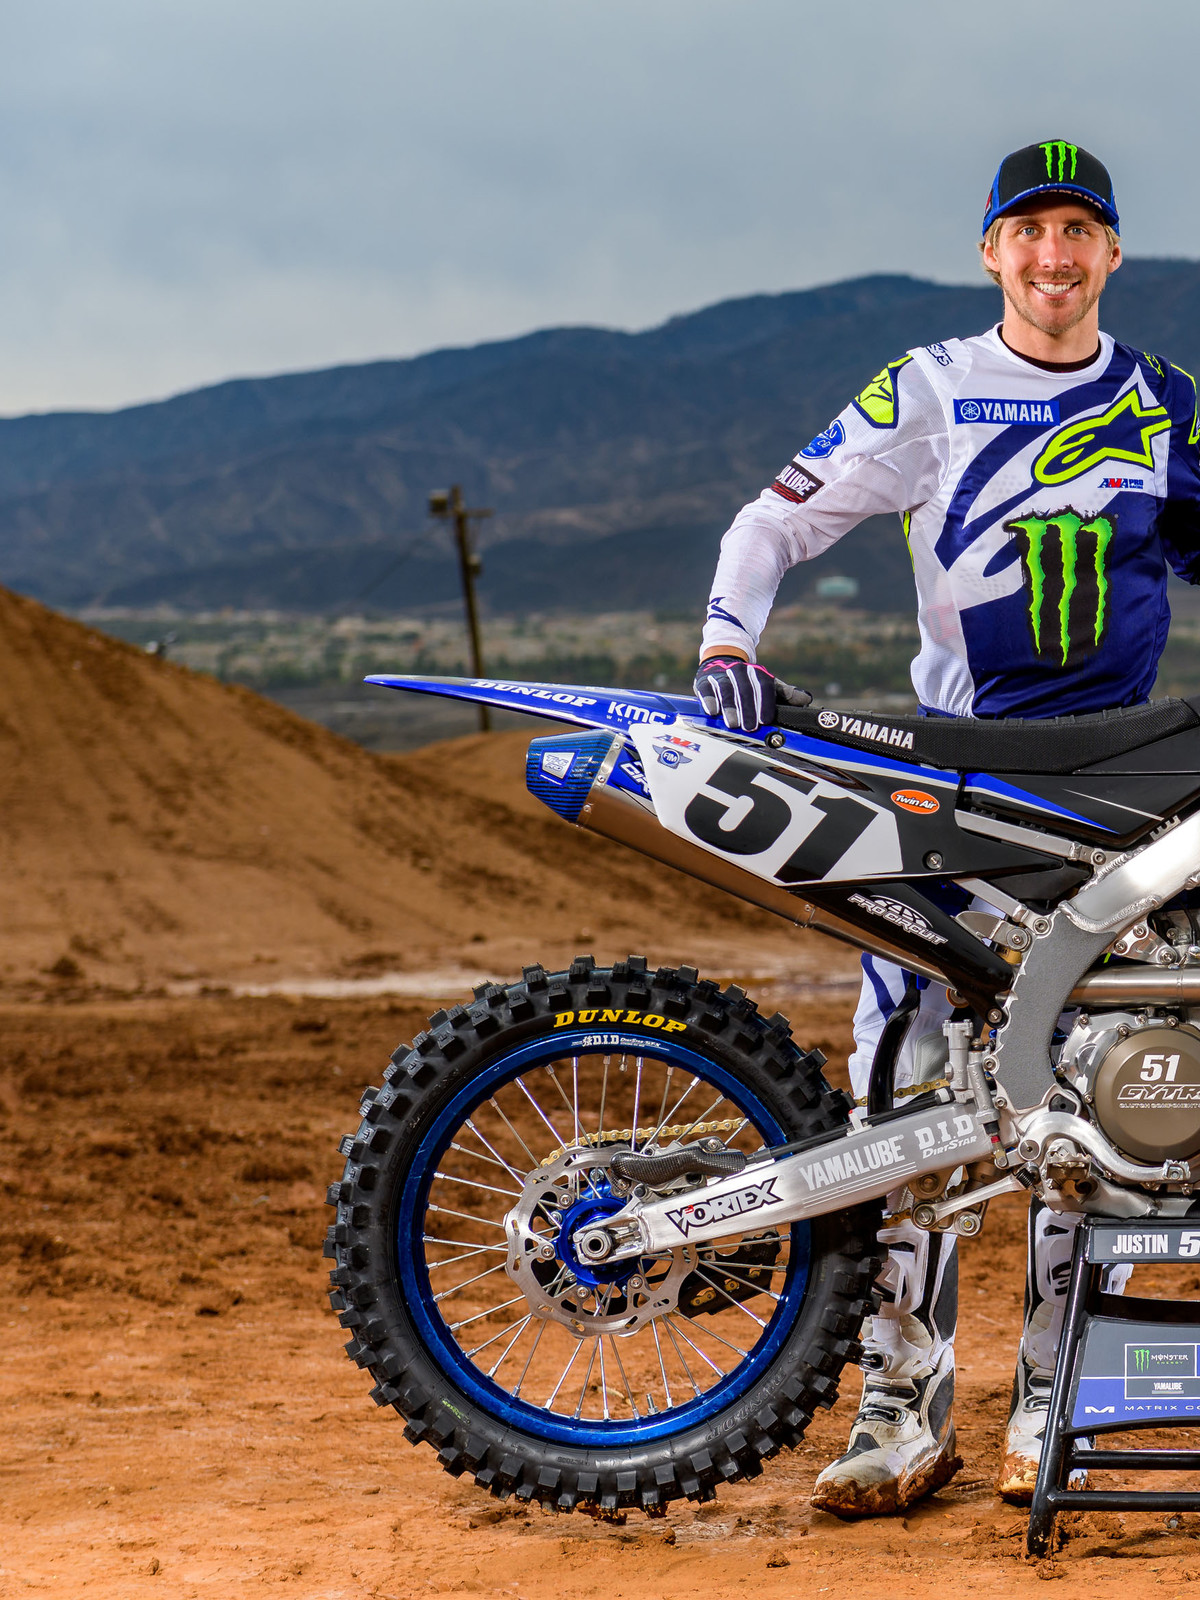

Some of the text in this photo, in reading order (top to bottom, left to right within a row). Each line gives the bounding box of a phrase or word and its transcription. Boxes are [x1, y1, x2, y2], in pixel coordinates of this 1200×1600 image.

[981, 401, 1054, 424] YAMAHA
[1098, 478, 1128, 489] AMA
[470, 680, 598, 708] DUNLOP
[607, 701, 666, 726] KMC
[653, 733, 702, 753] AMA
[840, 715, 914, 750] YAMAHA
[663, 752, 678, 762] FIM
[895, 794, 938, 810] Twin Air
[683, 748, 879, 885] 51
[847, 892, 949, 946] PRO CIRCUIT
[553, 1009, 688, 1033] DUNLOP
[1140, 1054, 1180, 1082] 51
[913, 1114, 974, 1150] D.I.D
[800, 1135, 905, 1192] YAMALUBE
[665, 1176, 784, 1238] VORTEX
[1112, 1233, 1169, 1254] JUSTIN
[1151, 1353, 1189, 1361] MONSTER
[1153, 1382, 1184, 1390] YAMALUBE
